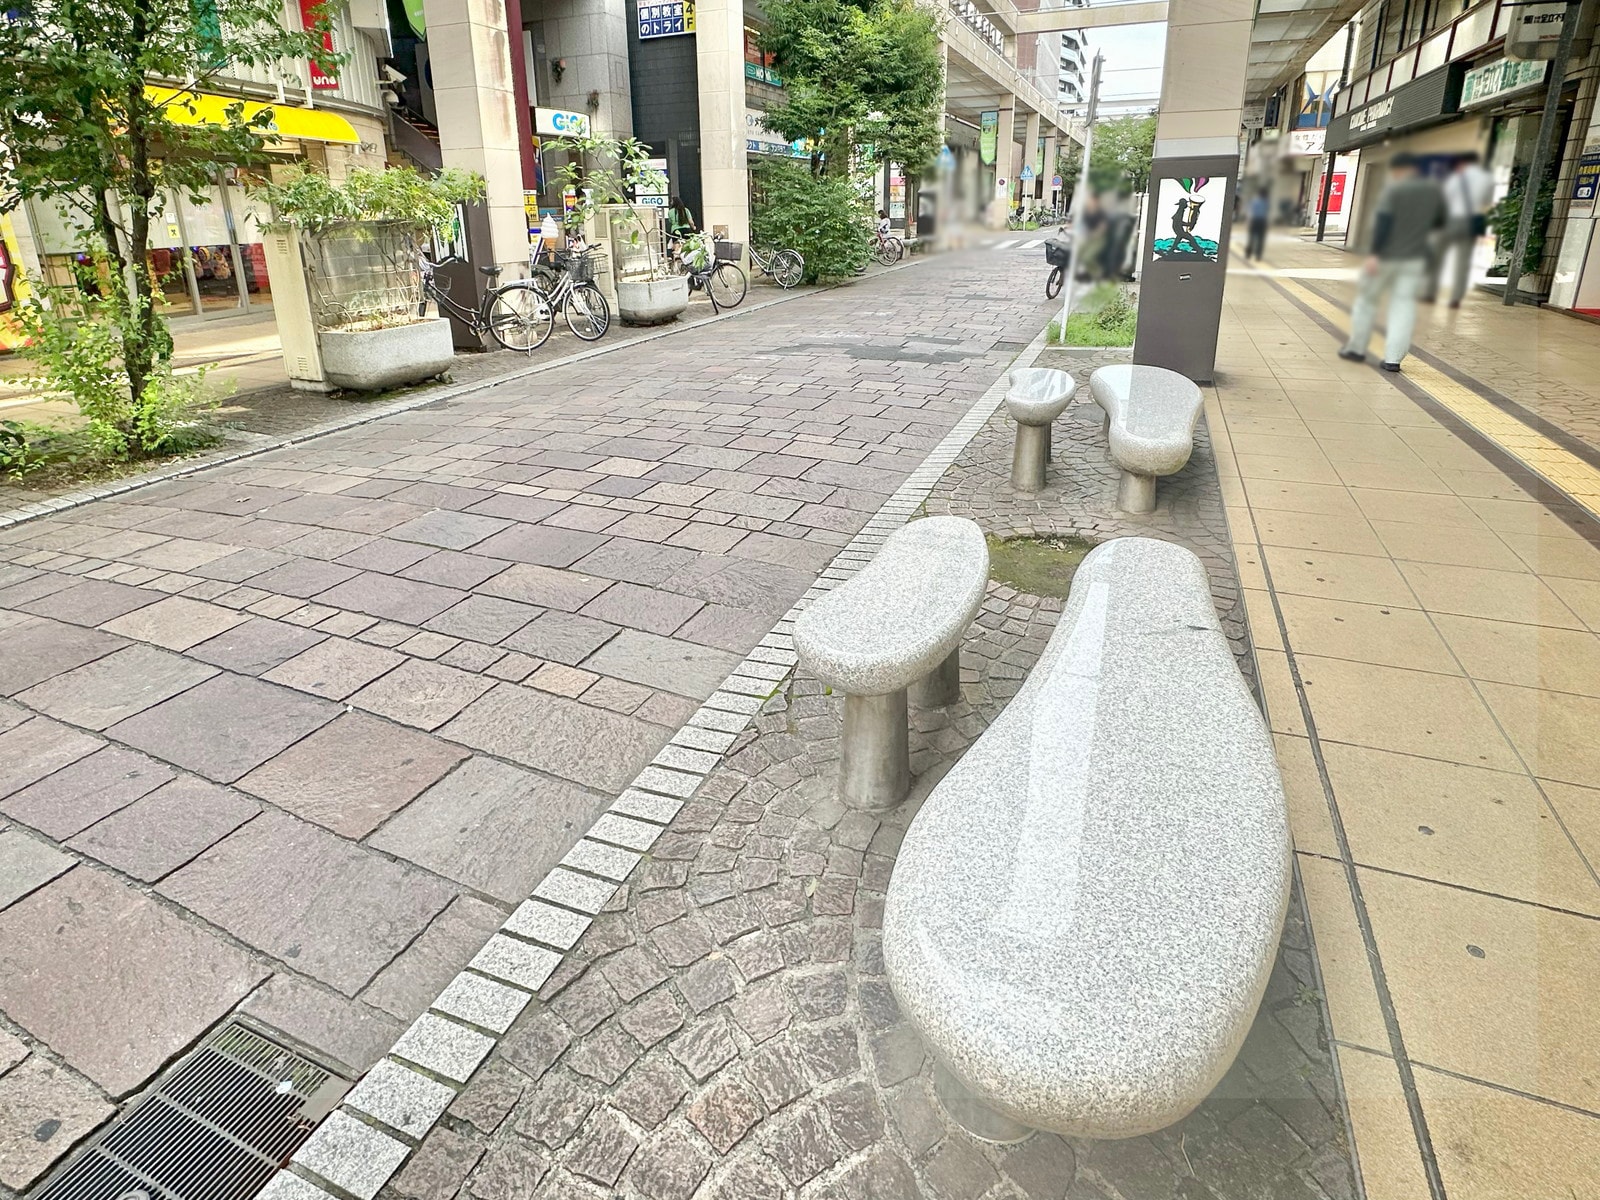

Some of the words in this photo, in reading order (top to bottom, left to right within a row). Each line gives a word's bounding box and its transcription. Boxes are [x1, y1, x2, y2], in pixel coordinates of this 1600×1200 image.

[641, 19, 683, 34] のトライ
[641, 197, 663, 206] GiGO
